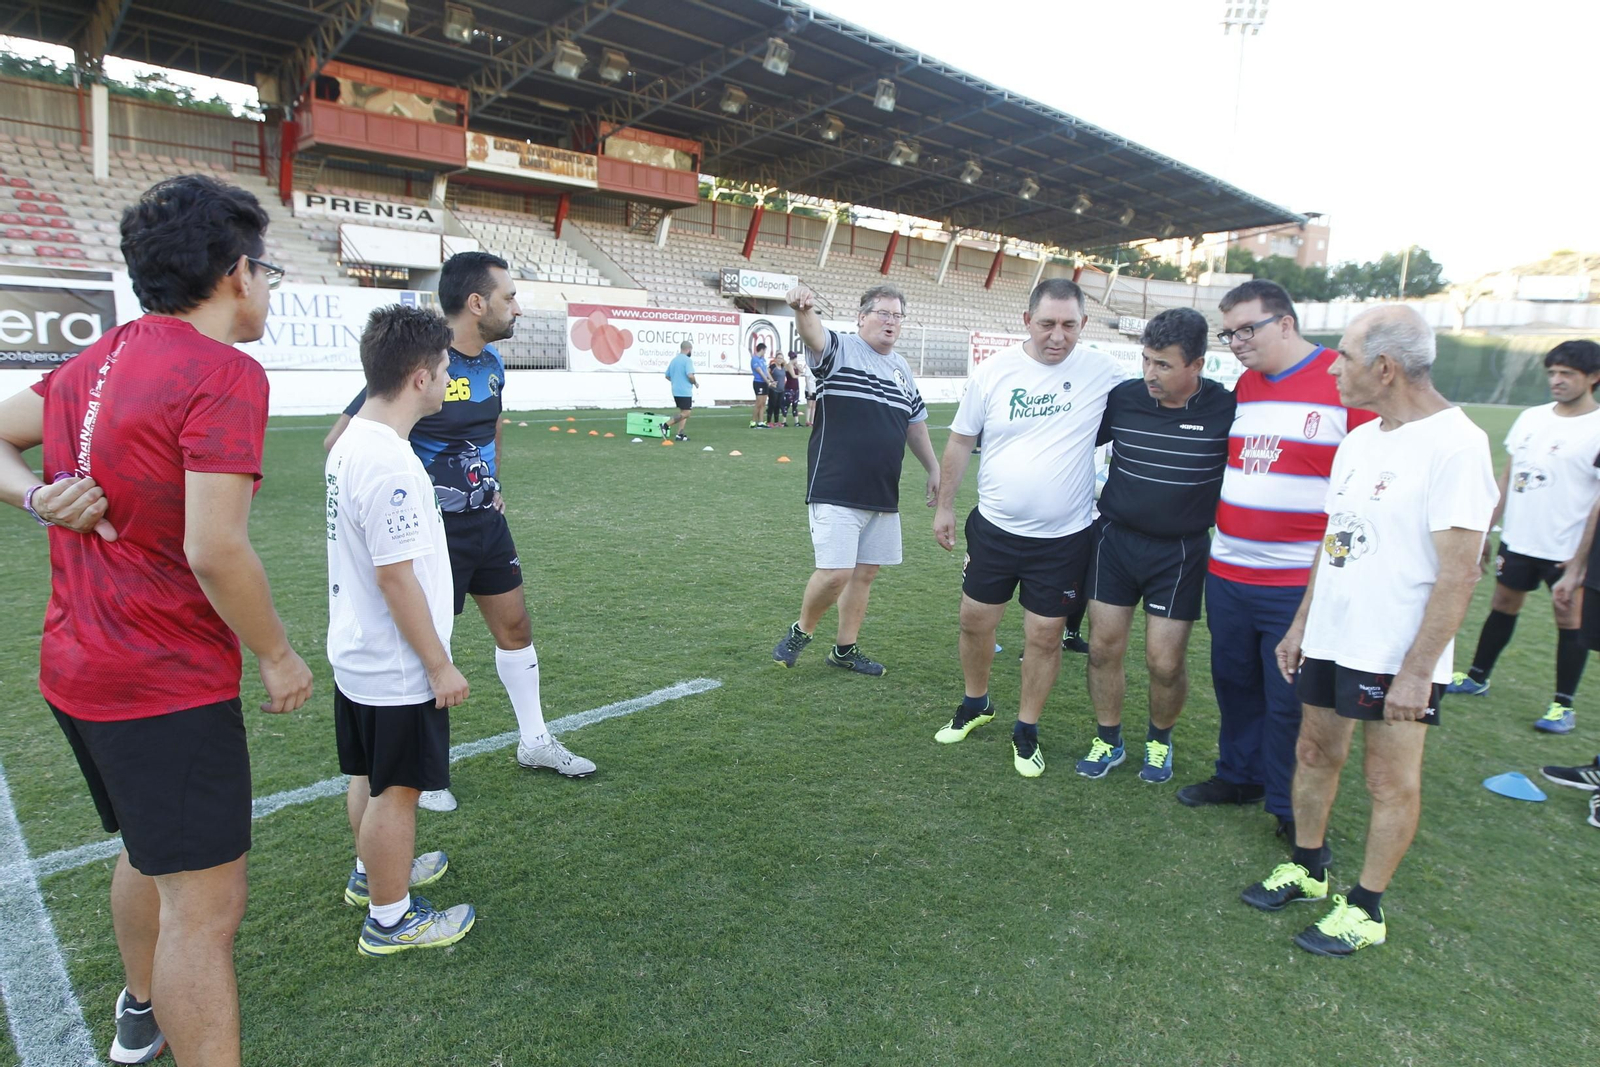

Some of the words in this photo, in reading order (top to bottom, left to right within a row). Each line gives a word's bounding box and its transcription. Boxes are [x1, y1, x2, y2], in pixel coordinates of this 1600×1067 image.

[585, 156, 594, 166] DE
[305, 194, 434, 223] PRENSA
[611, 308, 735, 324] www.conectapymes.net
[637, 330, 694, 344] CONECTA
[698, 332, 735, 346] PYMES
[444, 377, 471, 402] 26
[1009, 388, 1057, 408] RUGBY
[1244, 449, 1275, 459] WINAMAX
[389, 521, 419, 533] CLAN
